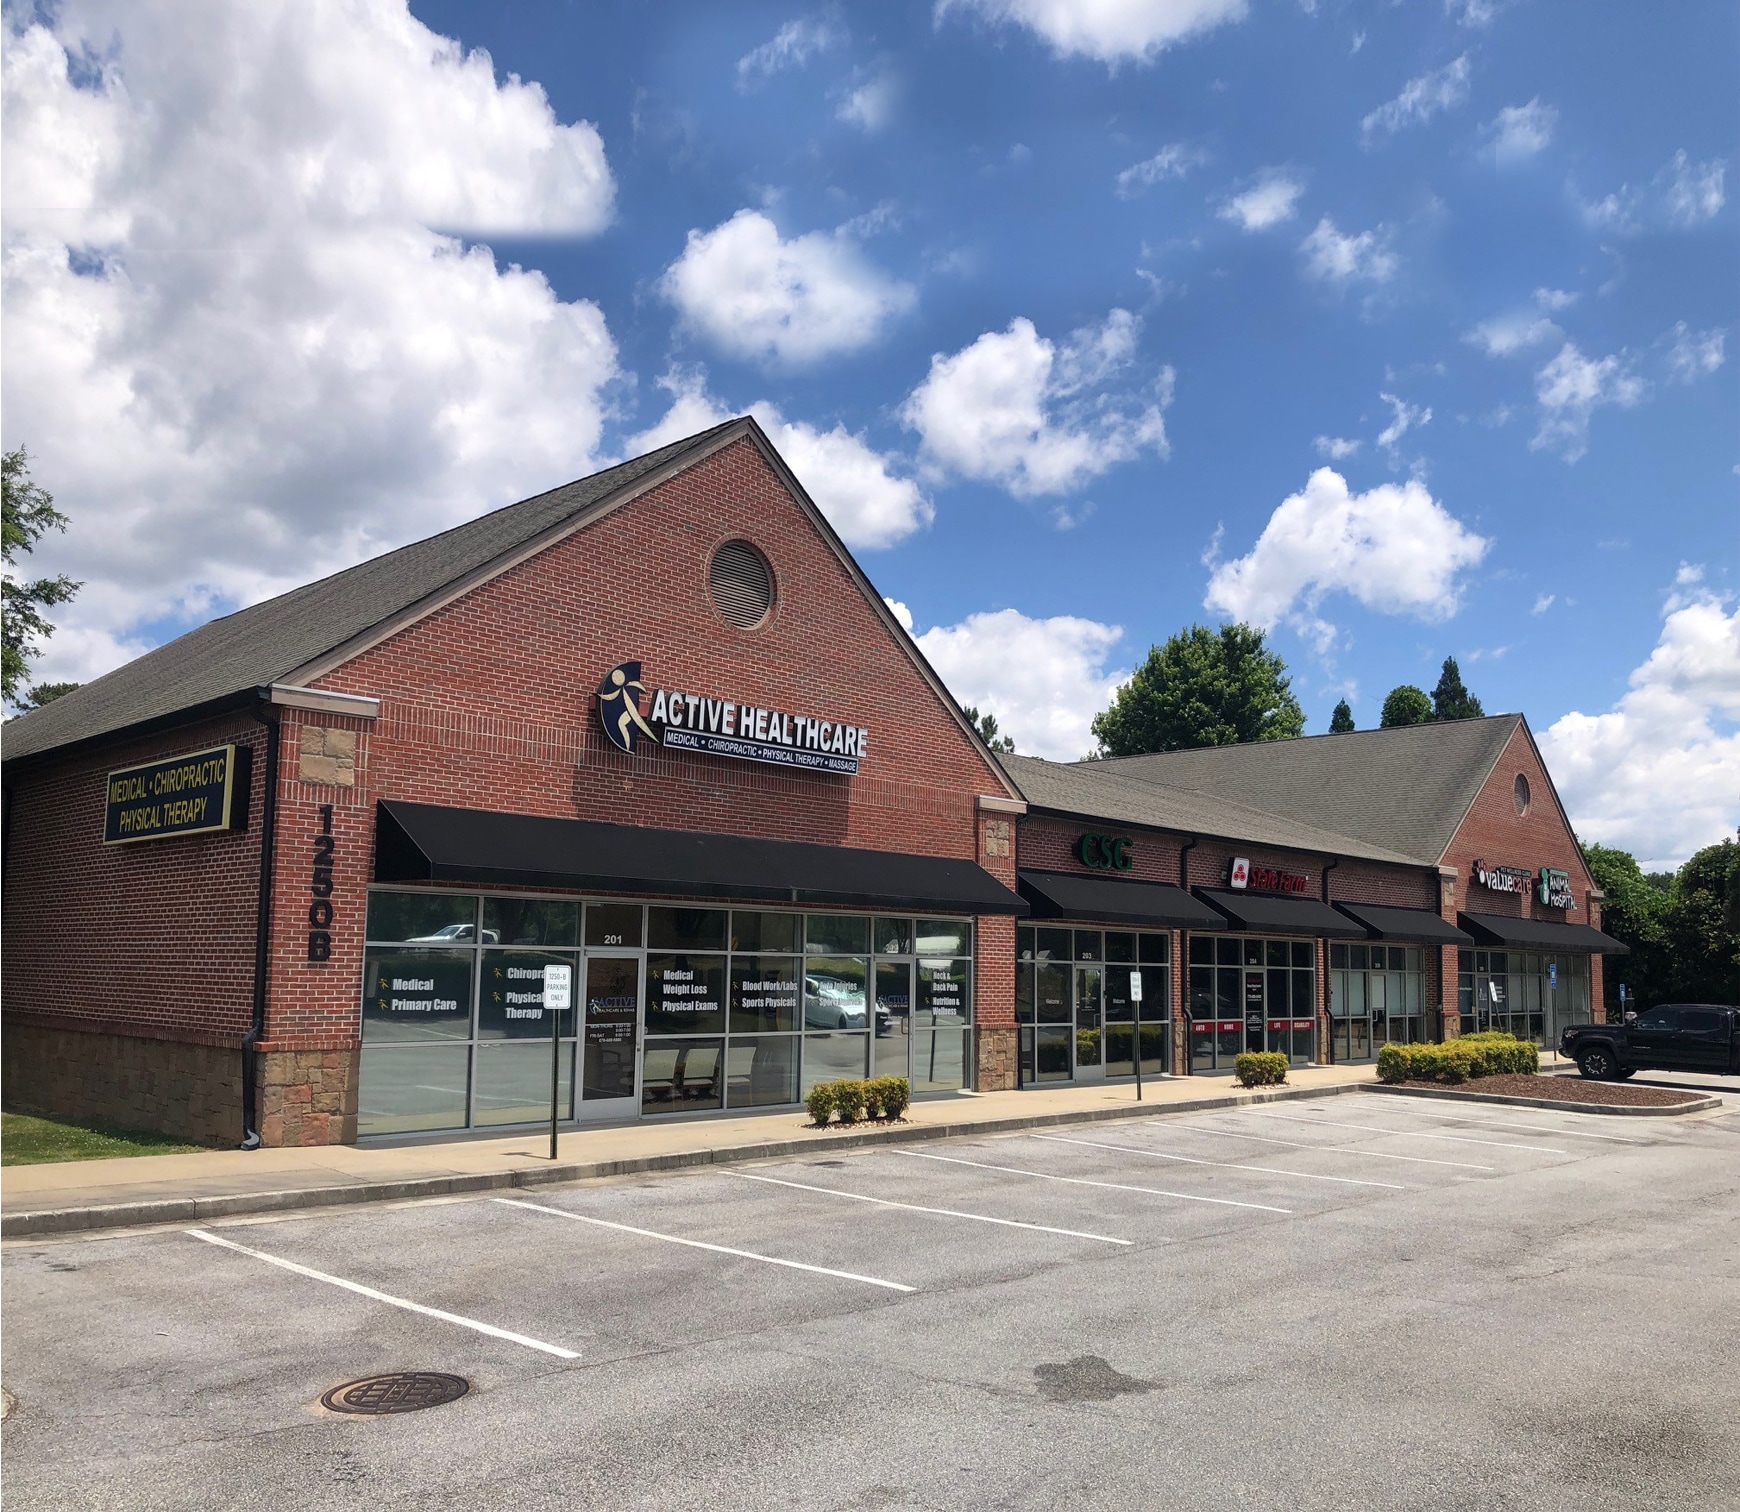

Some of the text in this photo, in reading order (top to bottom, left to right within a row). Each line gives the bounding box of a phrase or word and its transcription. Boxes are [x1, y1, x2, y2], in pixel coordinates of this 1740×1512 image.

[651, 689, 869, 758] ACTIVE HEALTHCARE
[666, 731, 857, 772] MEDICAL CHIROPRACTIC PHYSICAL THERAPY MASSAGE
[110, 758, 225, 804] MEDICAL CHIROPRACTIC
[119, 796, 208, 833] PHYSICAL THERAPY
[1081, 833, 1133, 870] CSG
[1250, 866, 1306, 893] State Farm
[1486, 869, 1532, 894] valuecare
[1549, 875, 1572, 893] ANIMAL
[604, 935, 622, 944] 201
[507, 967, 545, 980] Chiropra
[549, 973, 566, 981] 1250-B
[663, 970, 693, 980] Medical
[933, 971, 946, 980] Neck
[392, 978, 434, 991] Medical
[546, 983, 568, 991] PARKING
[662, 984, 707, 995] Weight Loss
[742, 981, 798, 991] Blood Work/Labs
[933, 982, 958, 992] Back Pain
[506, 992, 544, 1005] Physical
[599, 996, 636, 1008] ACTIVE
[741, 998, 797, 1008] Sports Physicals
[932, 996, 955, 1006] Nutrition
[391, 999, 457, 1012] Primary Care
[662, 1001, 718, 1012] Physical Exams
[932, 1006, 957, 1016] Wellness
[505, 1007, 543, 1019] Therapy
